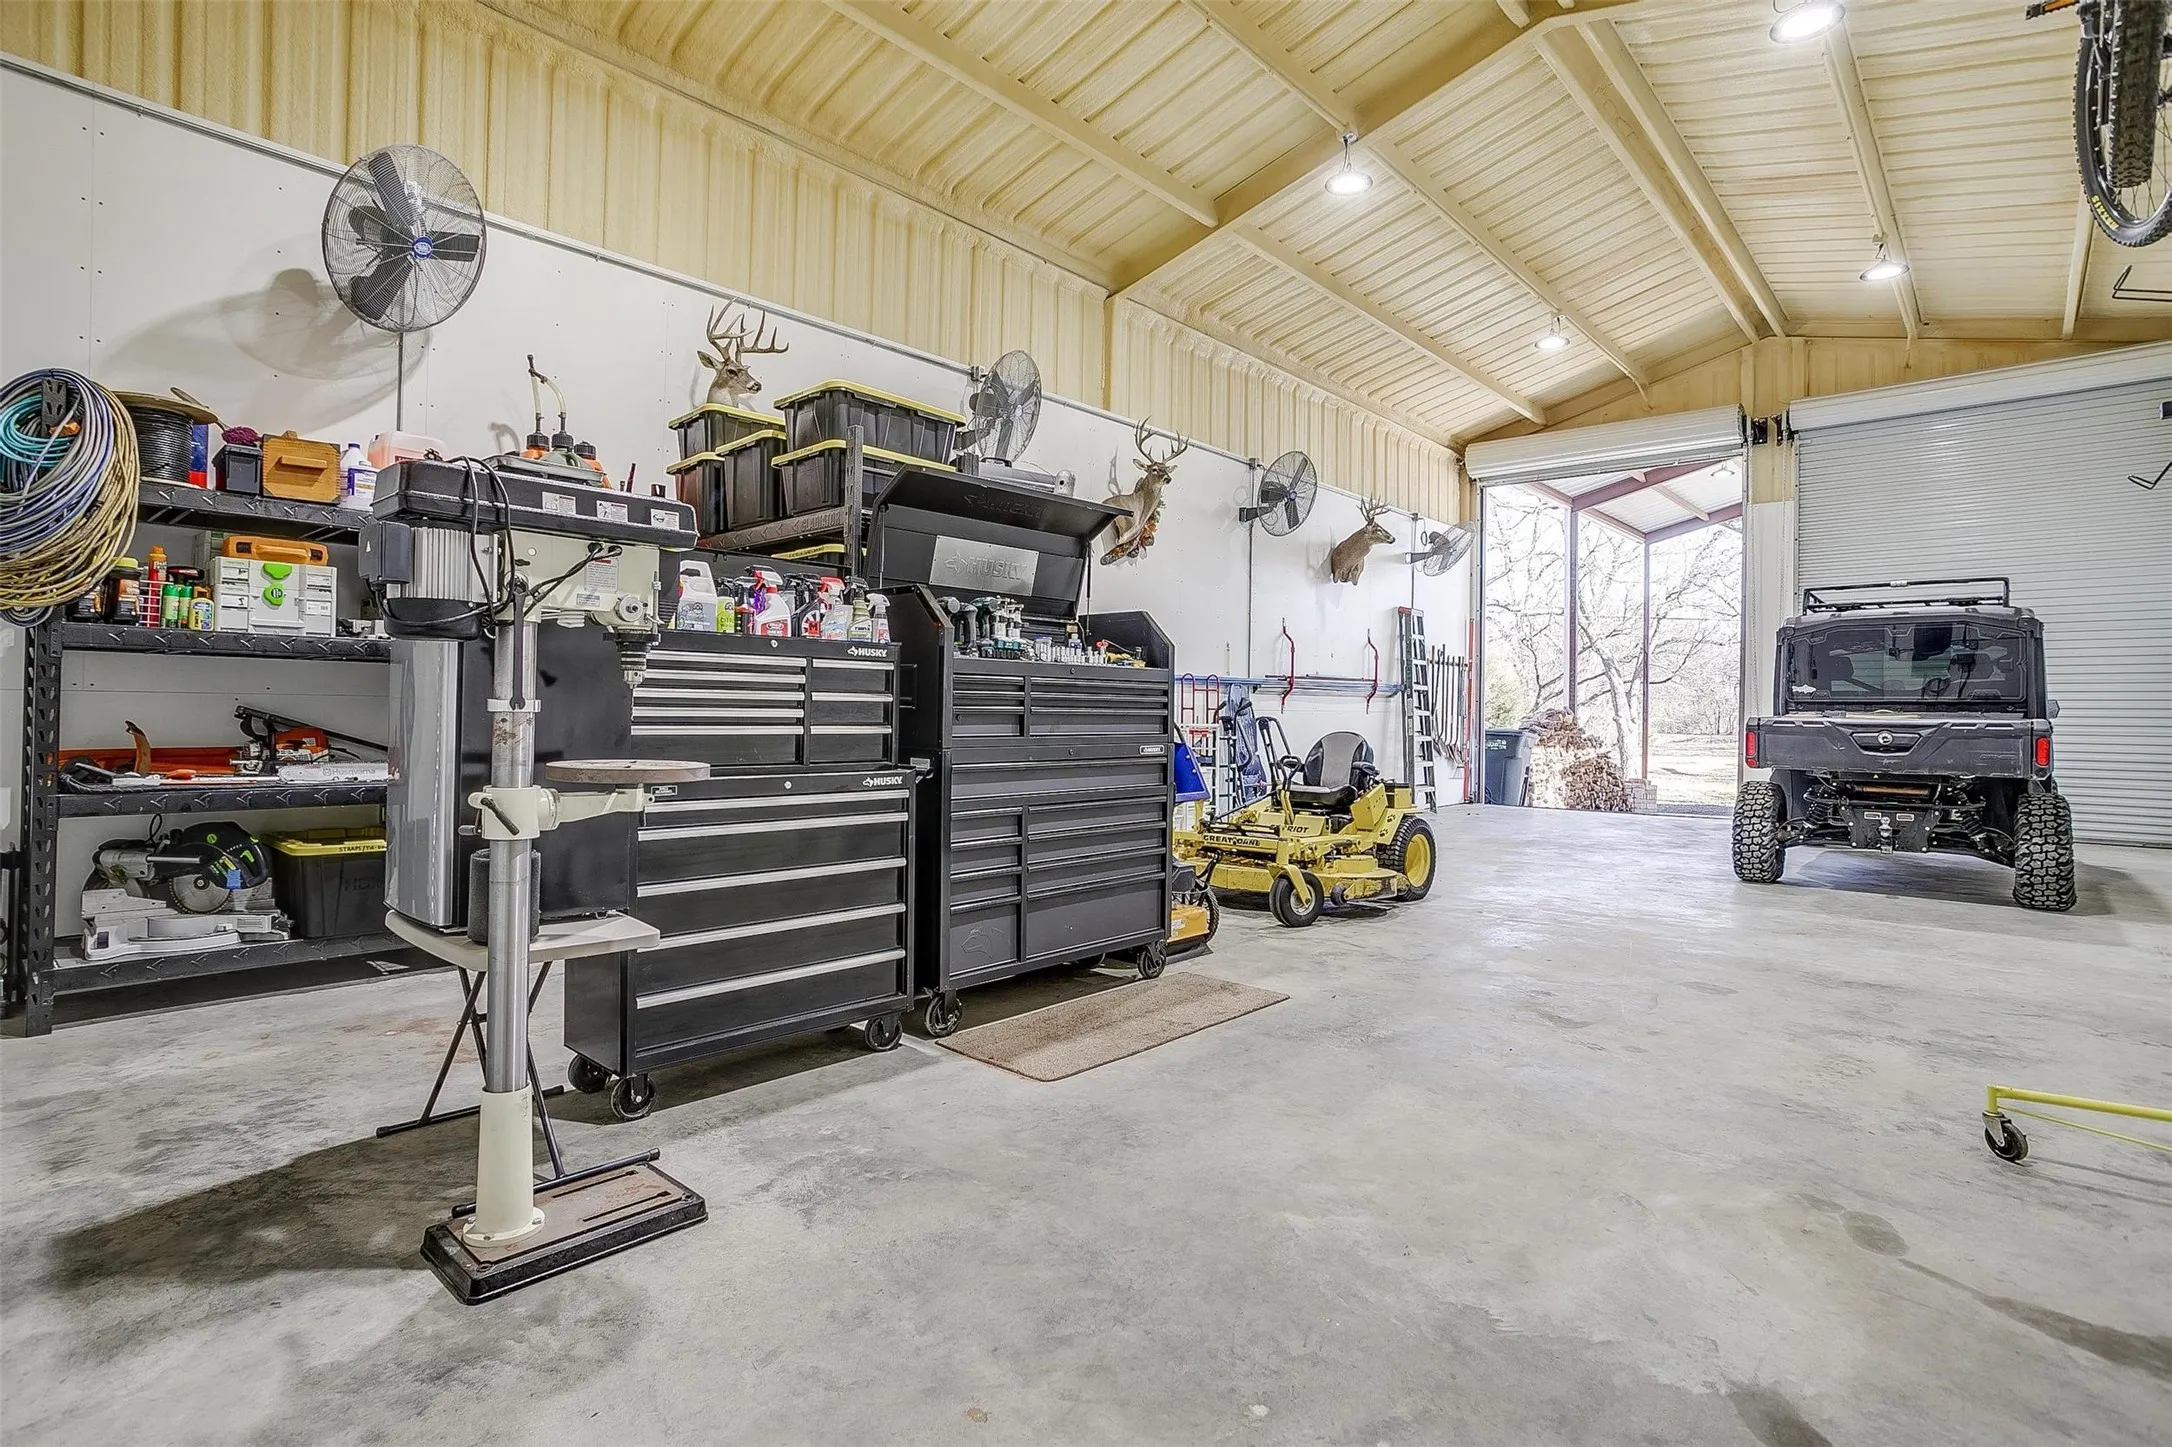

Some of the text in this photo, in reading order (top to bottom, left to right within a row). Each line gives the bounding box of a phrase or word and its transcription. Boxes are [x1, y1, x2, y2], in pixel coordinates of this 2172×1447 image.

[2091, 195, 2119, 230] MAXXIS
[858, 647, 888, 657] HUSKY
[331, 767, 376, 776] Husqvarna
[873, 776, 903, 786] HUSKY
[1203, 834, 1260, 847] GREAT DANE
